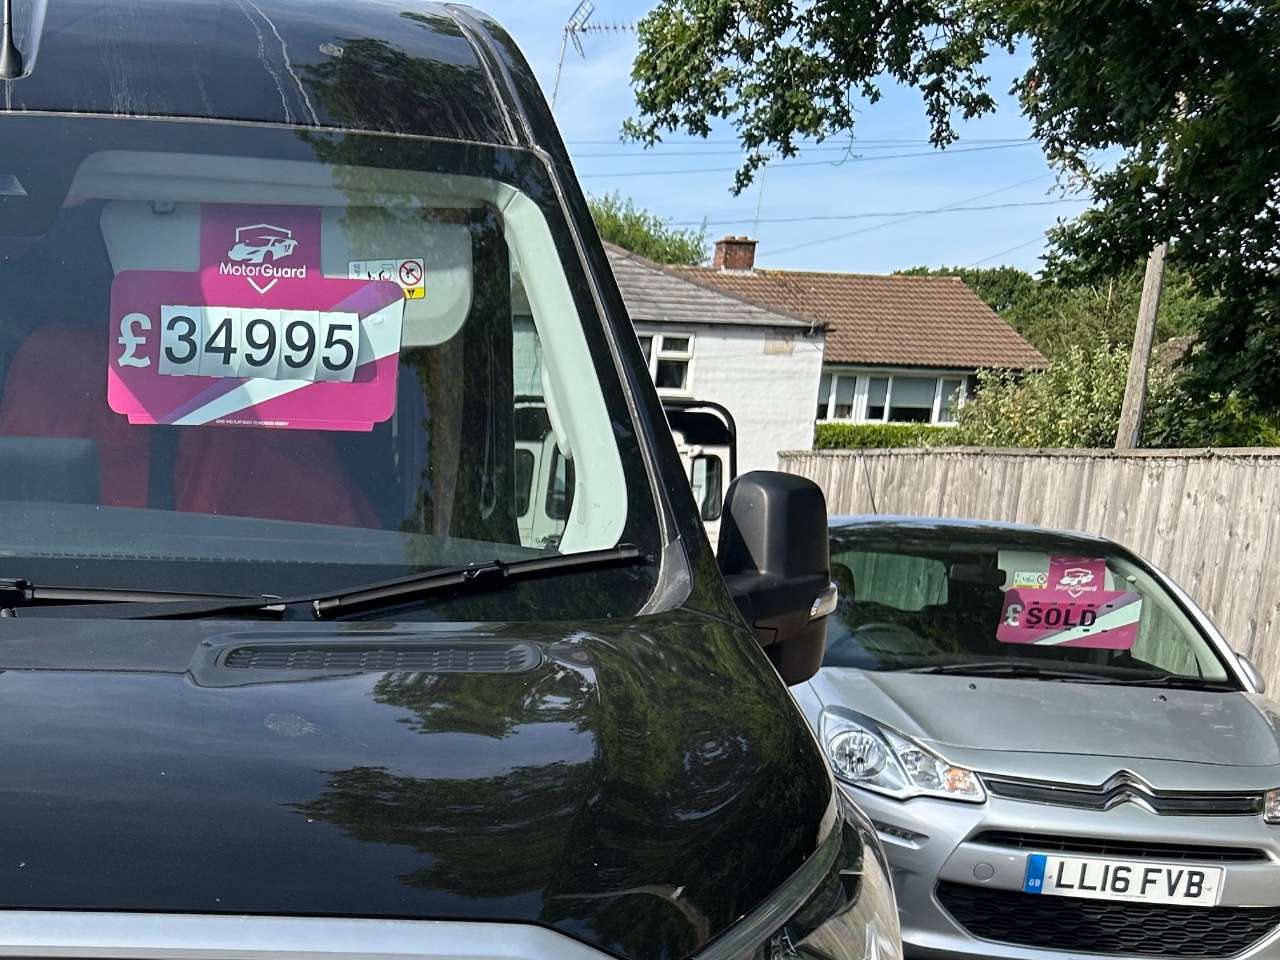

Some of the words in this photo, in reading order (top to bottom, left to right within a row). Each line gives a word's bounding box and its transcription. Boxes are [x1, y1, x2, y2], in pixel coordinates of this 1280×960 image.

[219, 262, 307, 279] MotorGuard
[1055, 584, 1098, 593] MotorGuard
[1055, 861, 1132, 893] LL16
[1140, 867, 1205, 898] FVB
